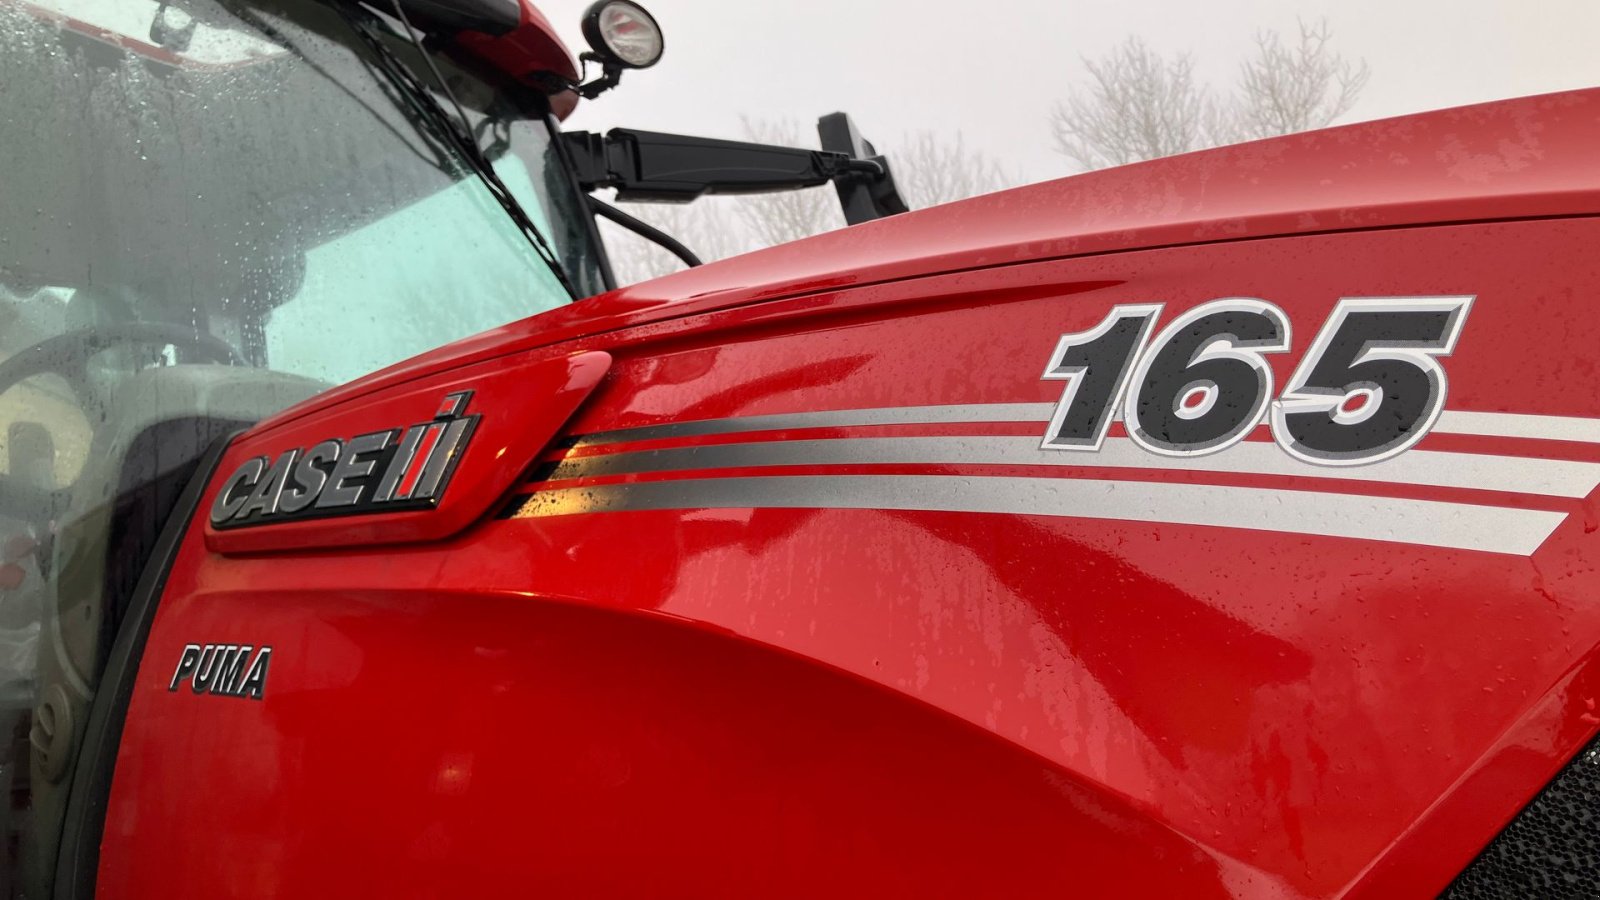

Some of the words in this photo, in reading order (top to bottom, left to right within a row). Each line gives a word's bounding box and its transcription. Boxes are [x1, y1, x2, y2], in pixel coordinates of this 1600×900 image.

[1040, 295, 1477, 466] 165
[211, 431, 399, 524] CASE
[169, 644, 271, 698] PUMA
